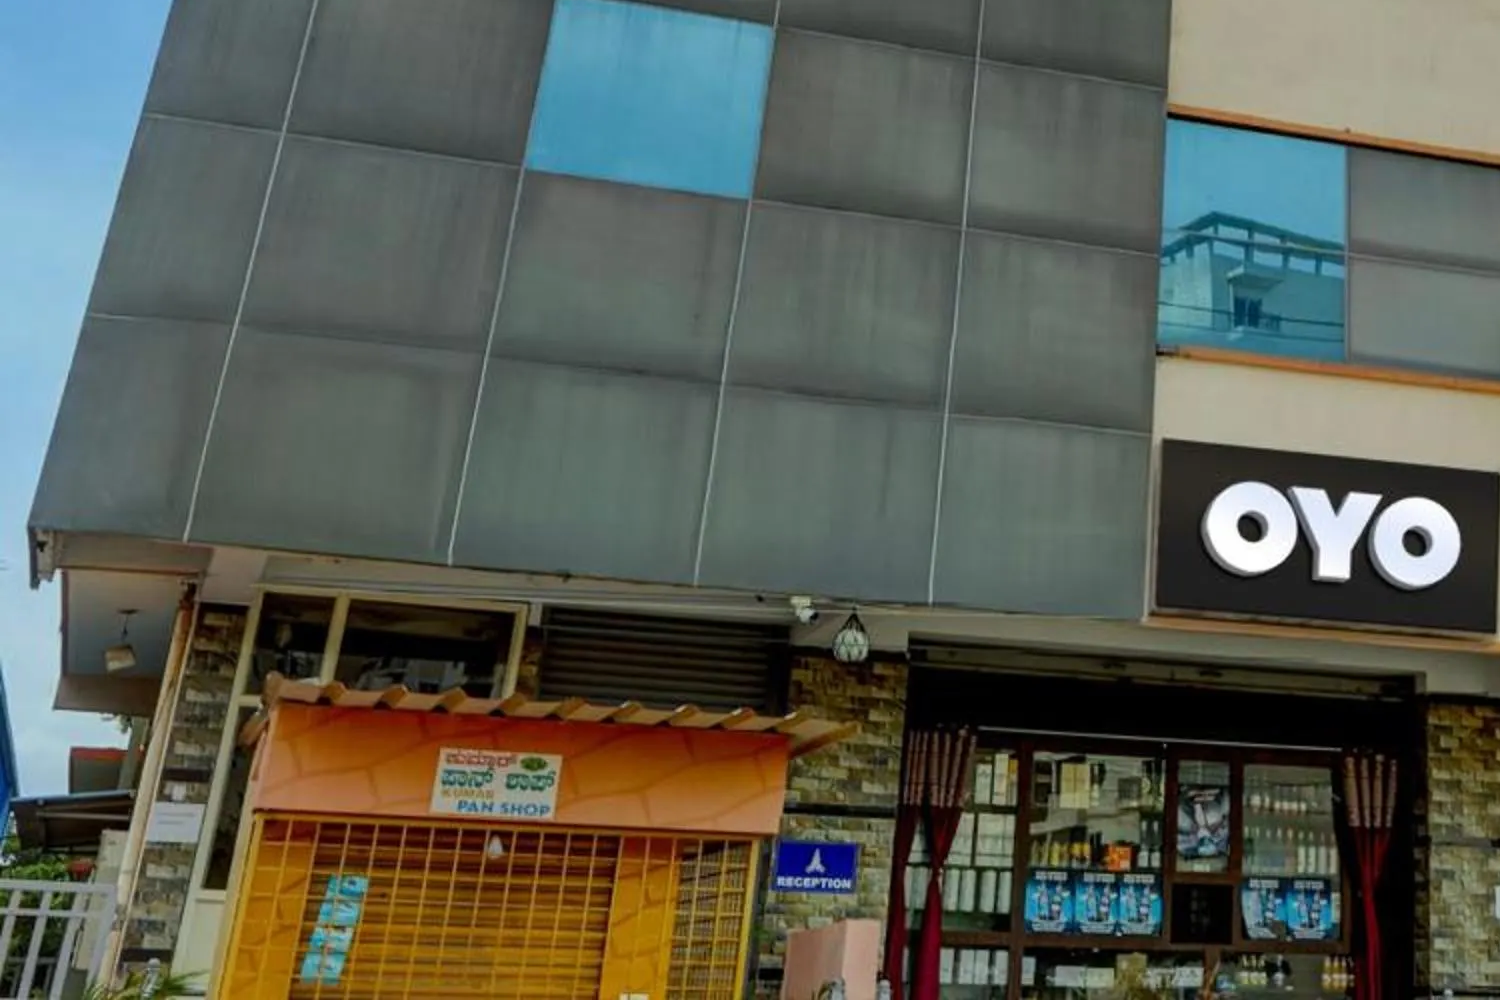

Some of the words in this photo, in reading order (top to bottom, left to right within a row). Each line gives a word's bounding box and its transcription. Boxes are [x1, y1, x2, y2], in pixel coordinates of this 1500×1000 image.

[1201, 481, 1461, 590] OYO
[457, 799, 494, 813] PAN
[500, 802, 550, 817] SHOP
[776, 875, 852, 889] RECEPTION
